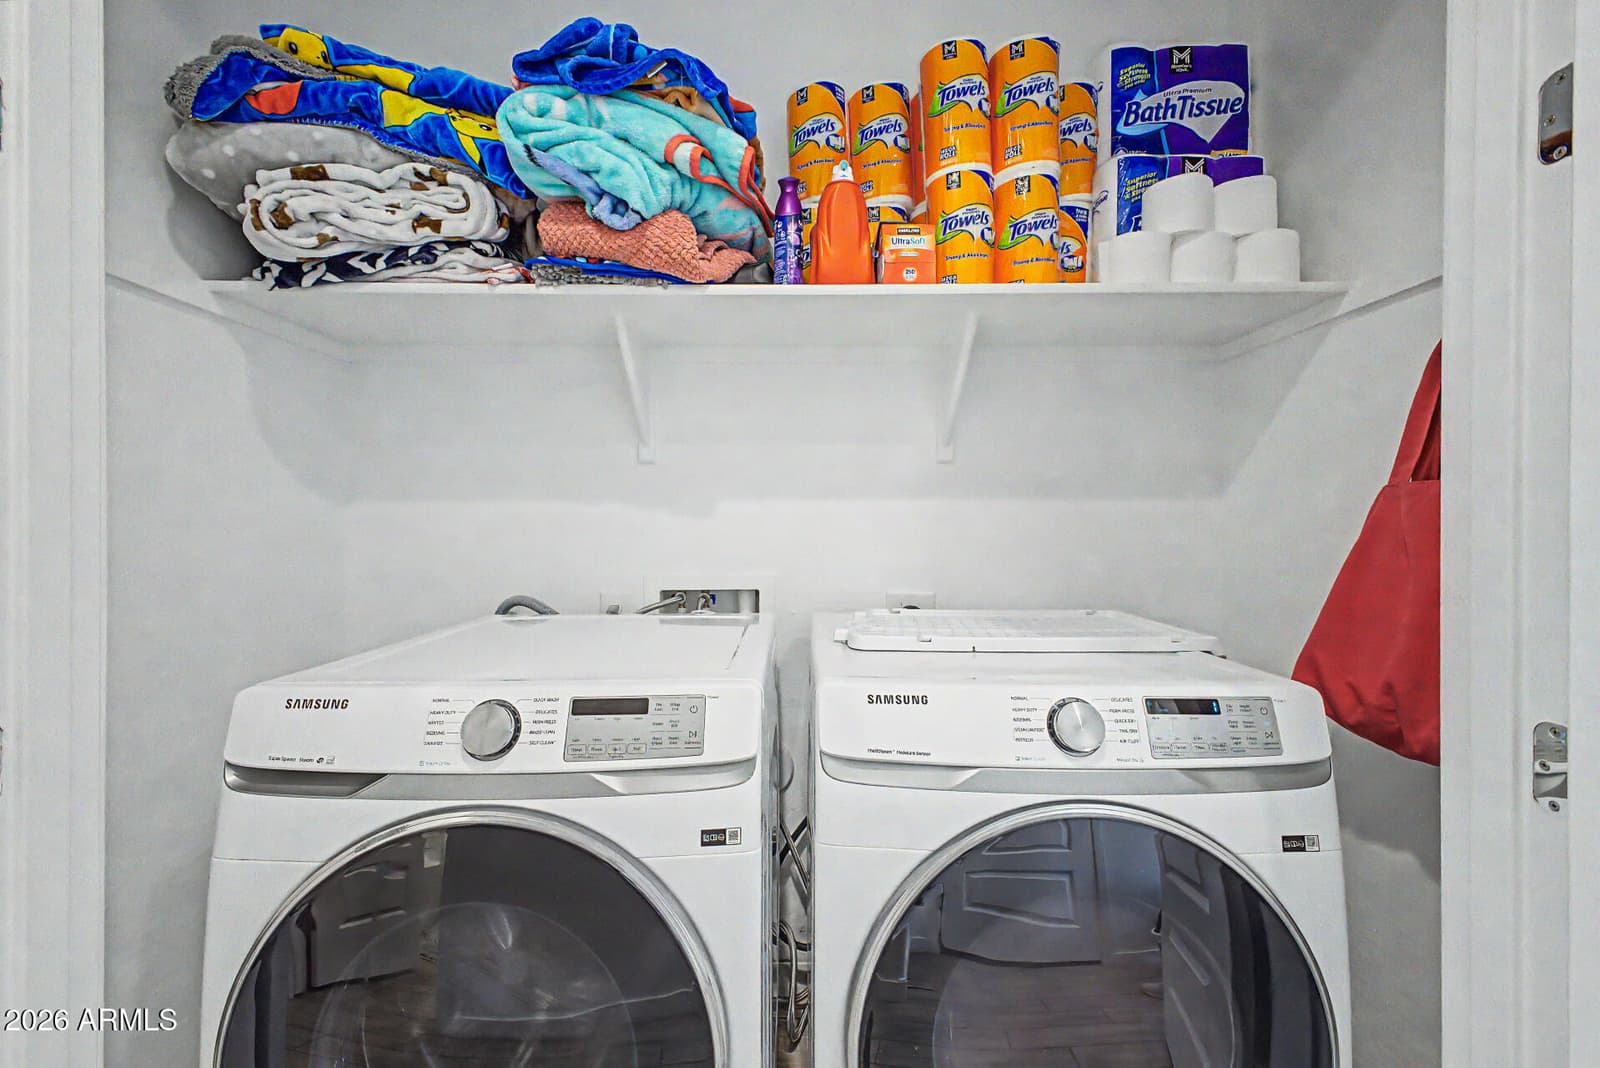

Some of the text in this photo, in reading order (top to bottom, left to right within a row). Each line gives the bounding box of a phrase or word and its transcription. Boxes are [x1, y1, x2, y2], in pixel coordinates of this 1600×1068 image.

[937, 80, 986, 108] Towels
[1004, 77, 1054, 108] Towels
[1163, 90, 1181, 98] Ultra
[793, 118, 836, 149] Towels
[858, 118, 903, 147] Towels
[941, 211, 990, 236] Towels
[1008, 214, 1059, 242] Towels
[285, 698, 349, 710] SAMSUNG
[866, 694, 928, 705] SAMSUNG
